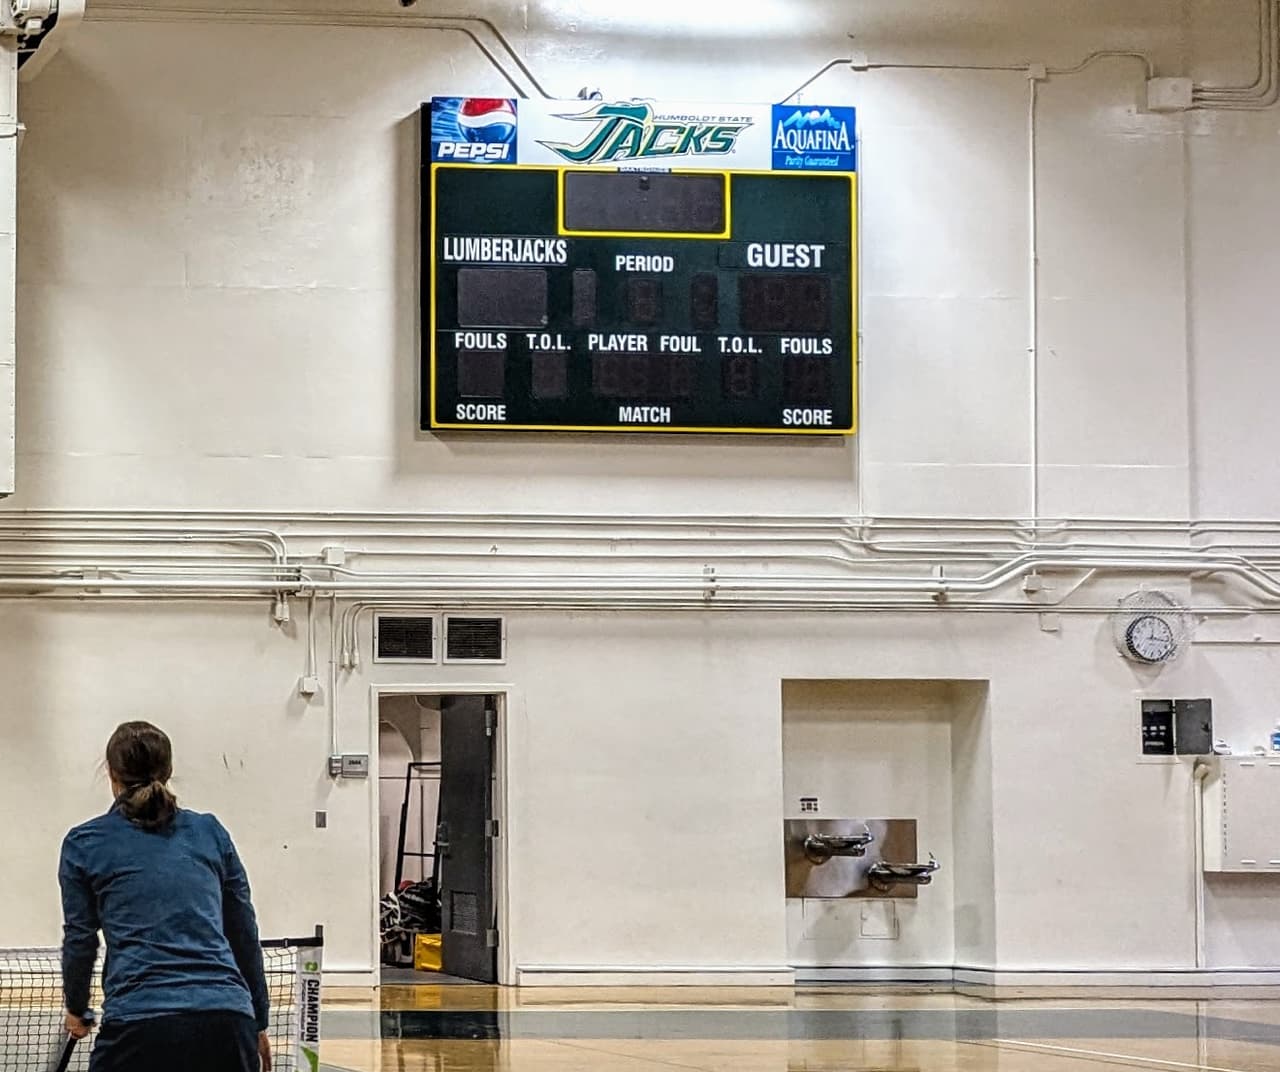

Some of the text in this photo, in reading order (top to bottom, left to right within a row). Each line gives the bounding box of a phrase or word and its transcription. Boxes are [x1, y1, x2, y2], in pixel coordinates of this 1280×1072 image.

[534, 101, 755, 165] JACKS
[773, 120, 852, 154] AQUAFINA
[437, 142, 510, 160] PEPSI
[443, 237, 567, 263] LUMBERJACKS
[747, 243, 825, 268] GUEST
[615, 255, 674, 273] PERIOD
[455, 333, 507, 350] FOULS
[526, 333, 571, 350] T.O.L.
[588, 334, 702, 352] PLAYER FOUL
[718, 336, 763, 353] T.O.L.
[780, 337, 833, 355] FOULS
[456, 404, 506, 421] SCORE
[618, 406, 671, 424] MATCH
[782, 408, 832, 426] SCORE
[306, 978, 320, 1042] CHAMPION
